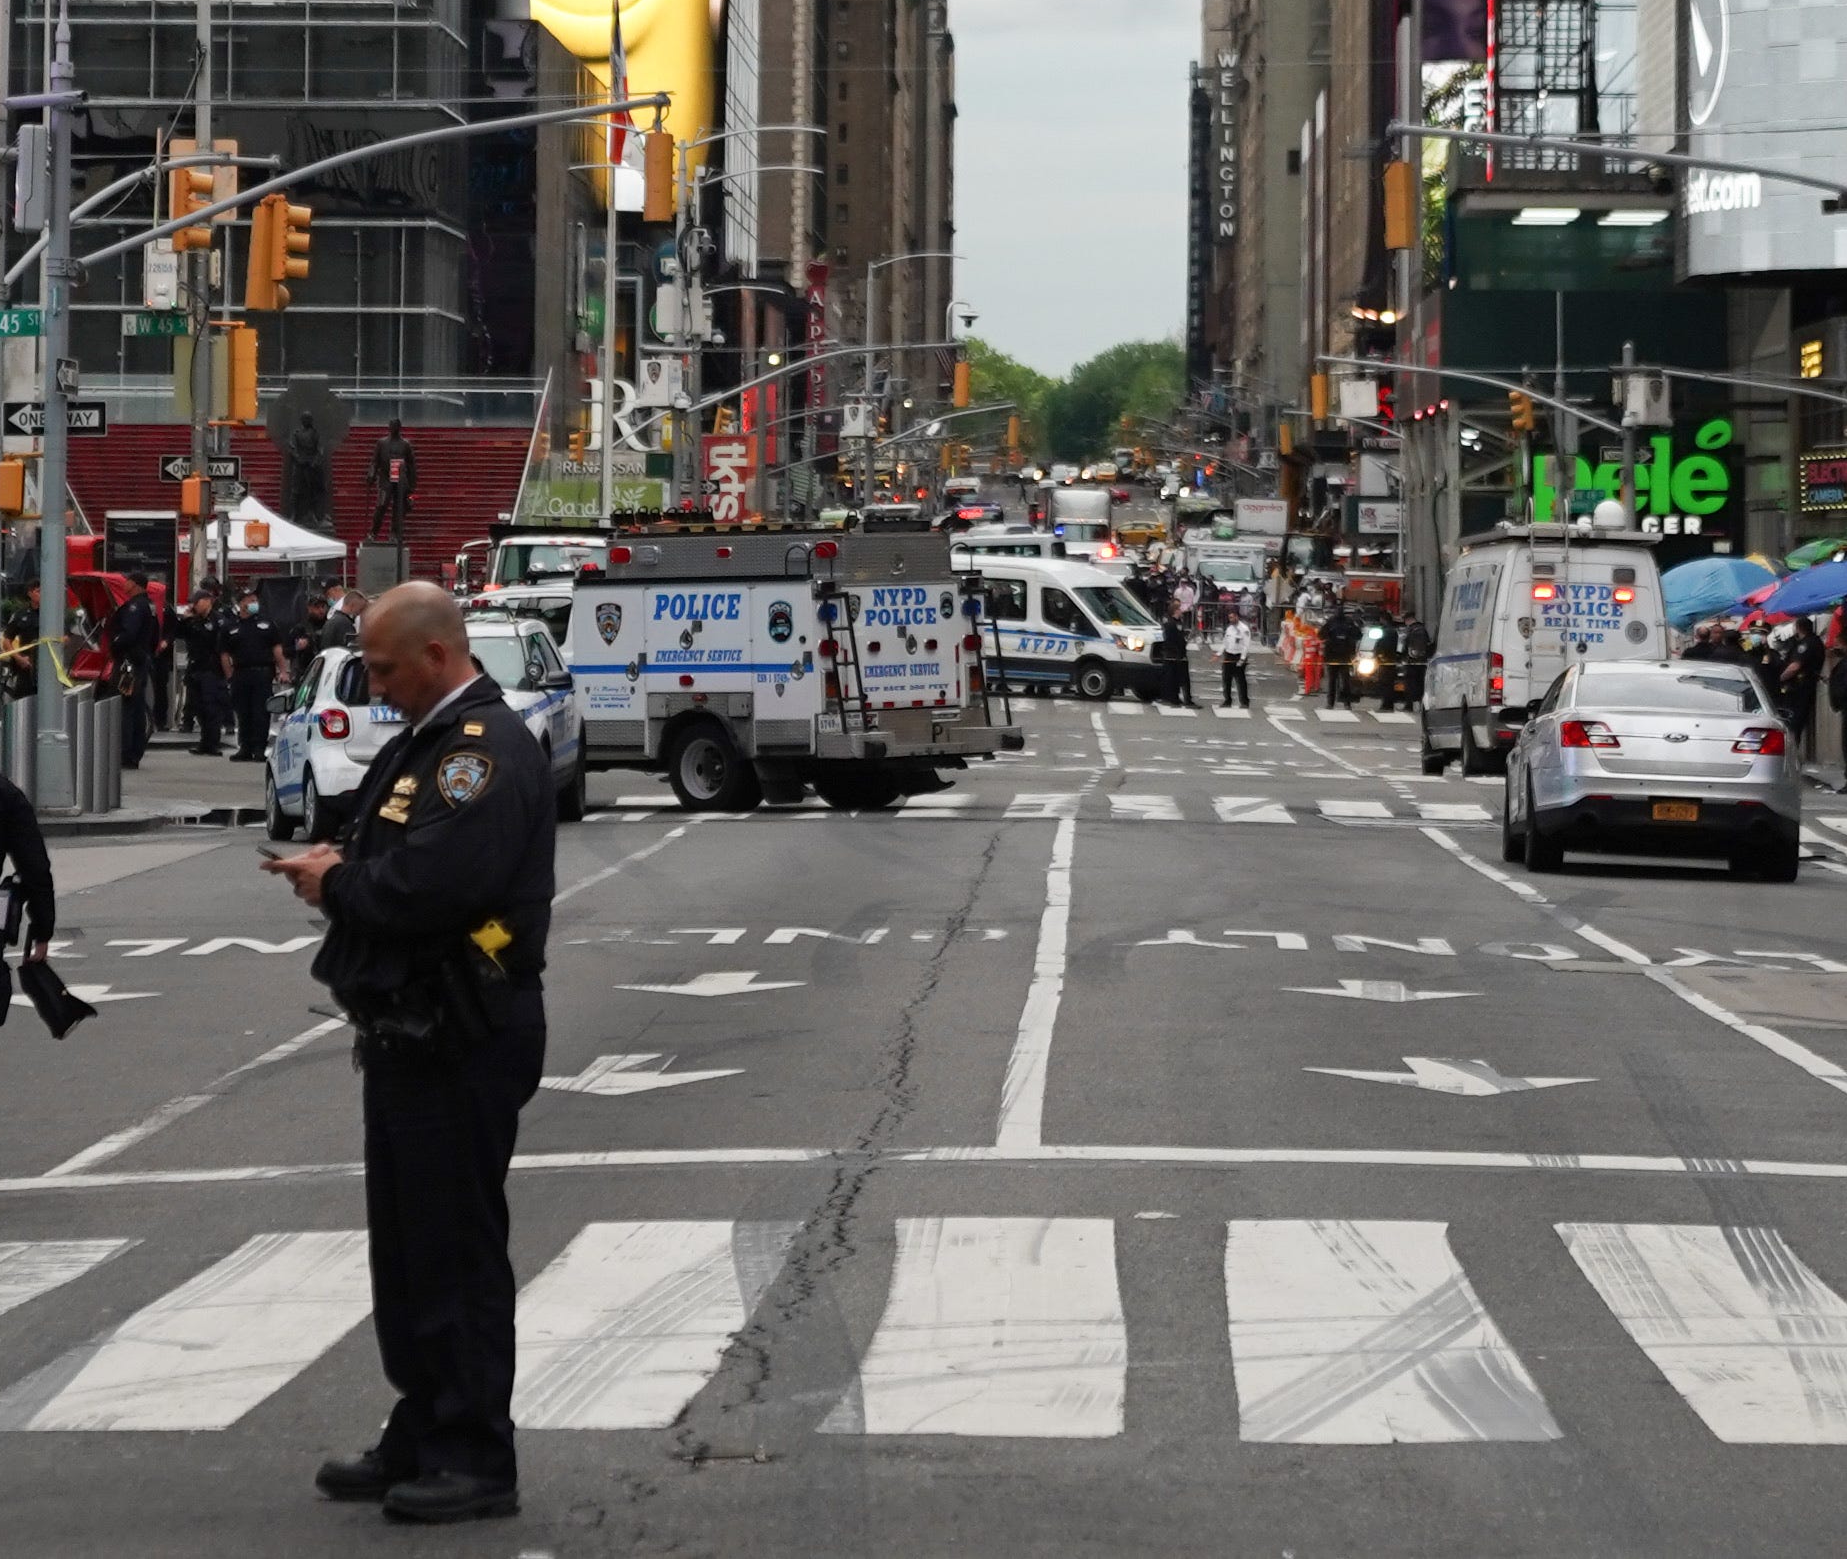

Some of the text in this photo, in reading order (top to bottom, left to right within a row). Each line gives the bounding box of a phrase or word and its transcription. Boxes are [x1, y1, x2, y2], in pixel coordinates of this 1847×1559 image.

[1217, 53, 1239, 237] WELLINGTON
[138, 318, 151, 334] W
[156, 316, 174, 334] 45
[18, 411, 94, 426] ONE WAY
[708, 441, 747, 522] tkts
[872, 587, 928, 607] NYPD
[1554, 584, 1612, 601] NYPD
[653, 593, 742, 621] POLICE
[1540, 601, 1624, 617] POLICE
[864, 607, 937, 627] POLICE
[1543, 617, 1621, 630] REAL TIME
[1016, 636, 1069, 656] NYPD
[1559, 631, 1605, 644] CRIME
[654, 648, 743, 663] EMERGENCY SERVICE
[863, 662, 940, 679] EMERGENCY SERVICE
[368, 706, 404, 722] NYP
[1114, 929, 1581, 962] ONLY
